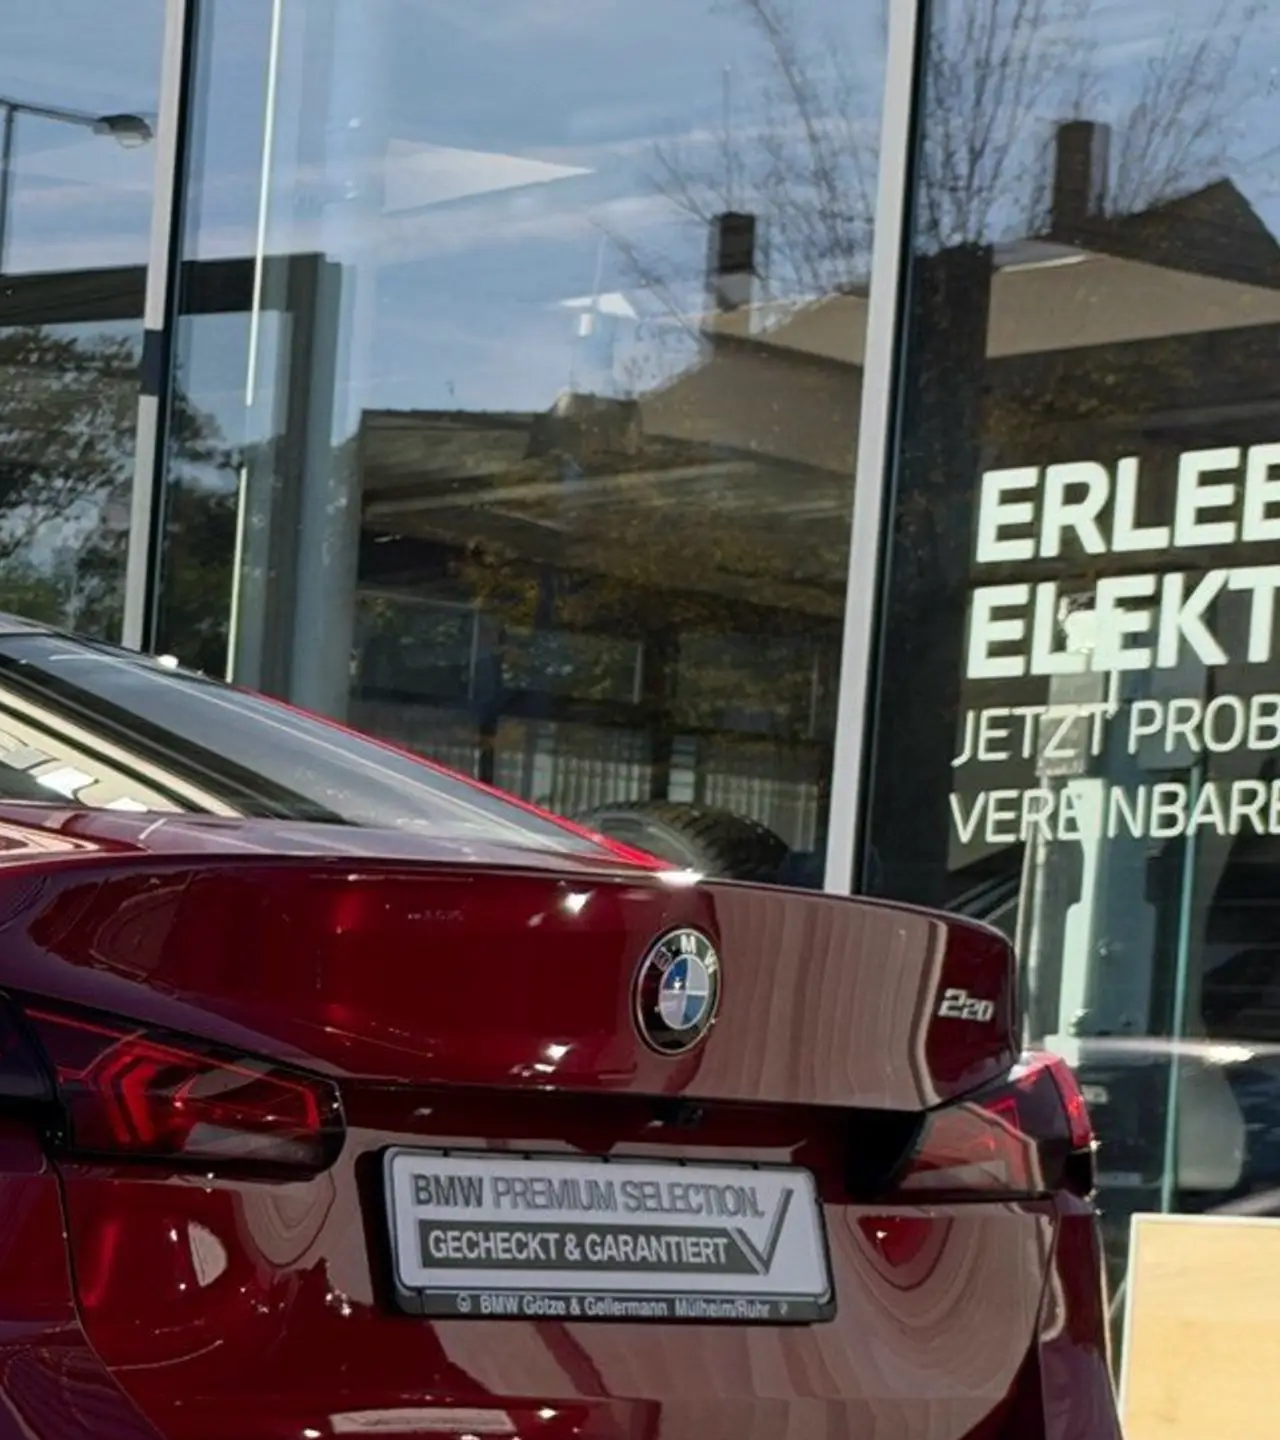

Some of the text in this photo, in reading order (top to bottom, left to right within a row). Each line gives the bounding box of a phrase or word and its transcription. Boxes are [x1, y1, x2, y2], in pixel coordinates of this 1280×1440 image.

[966, 565, 1280, 679] ELEKT
[950, 693, 1280, 768] JETZT PROB
[938, 987, 995, 1022] 220
[412, 1173, 483, 1208] BMW
[491, 1176, 619, 1212] PREMIUM
[428, 1229, 728, 1265] GECHECKT & GARANTIERT
[479, 1294, 520, 1315] BMW
[569, 1297, 581, 1316] &
